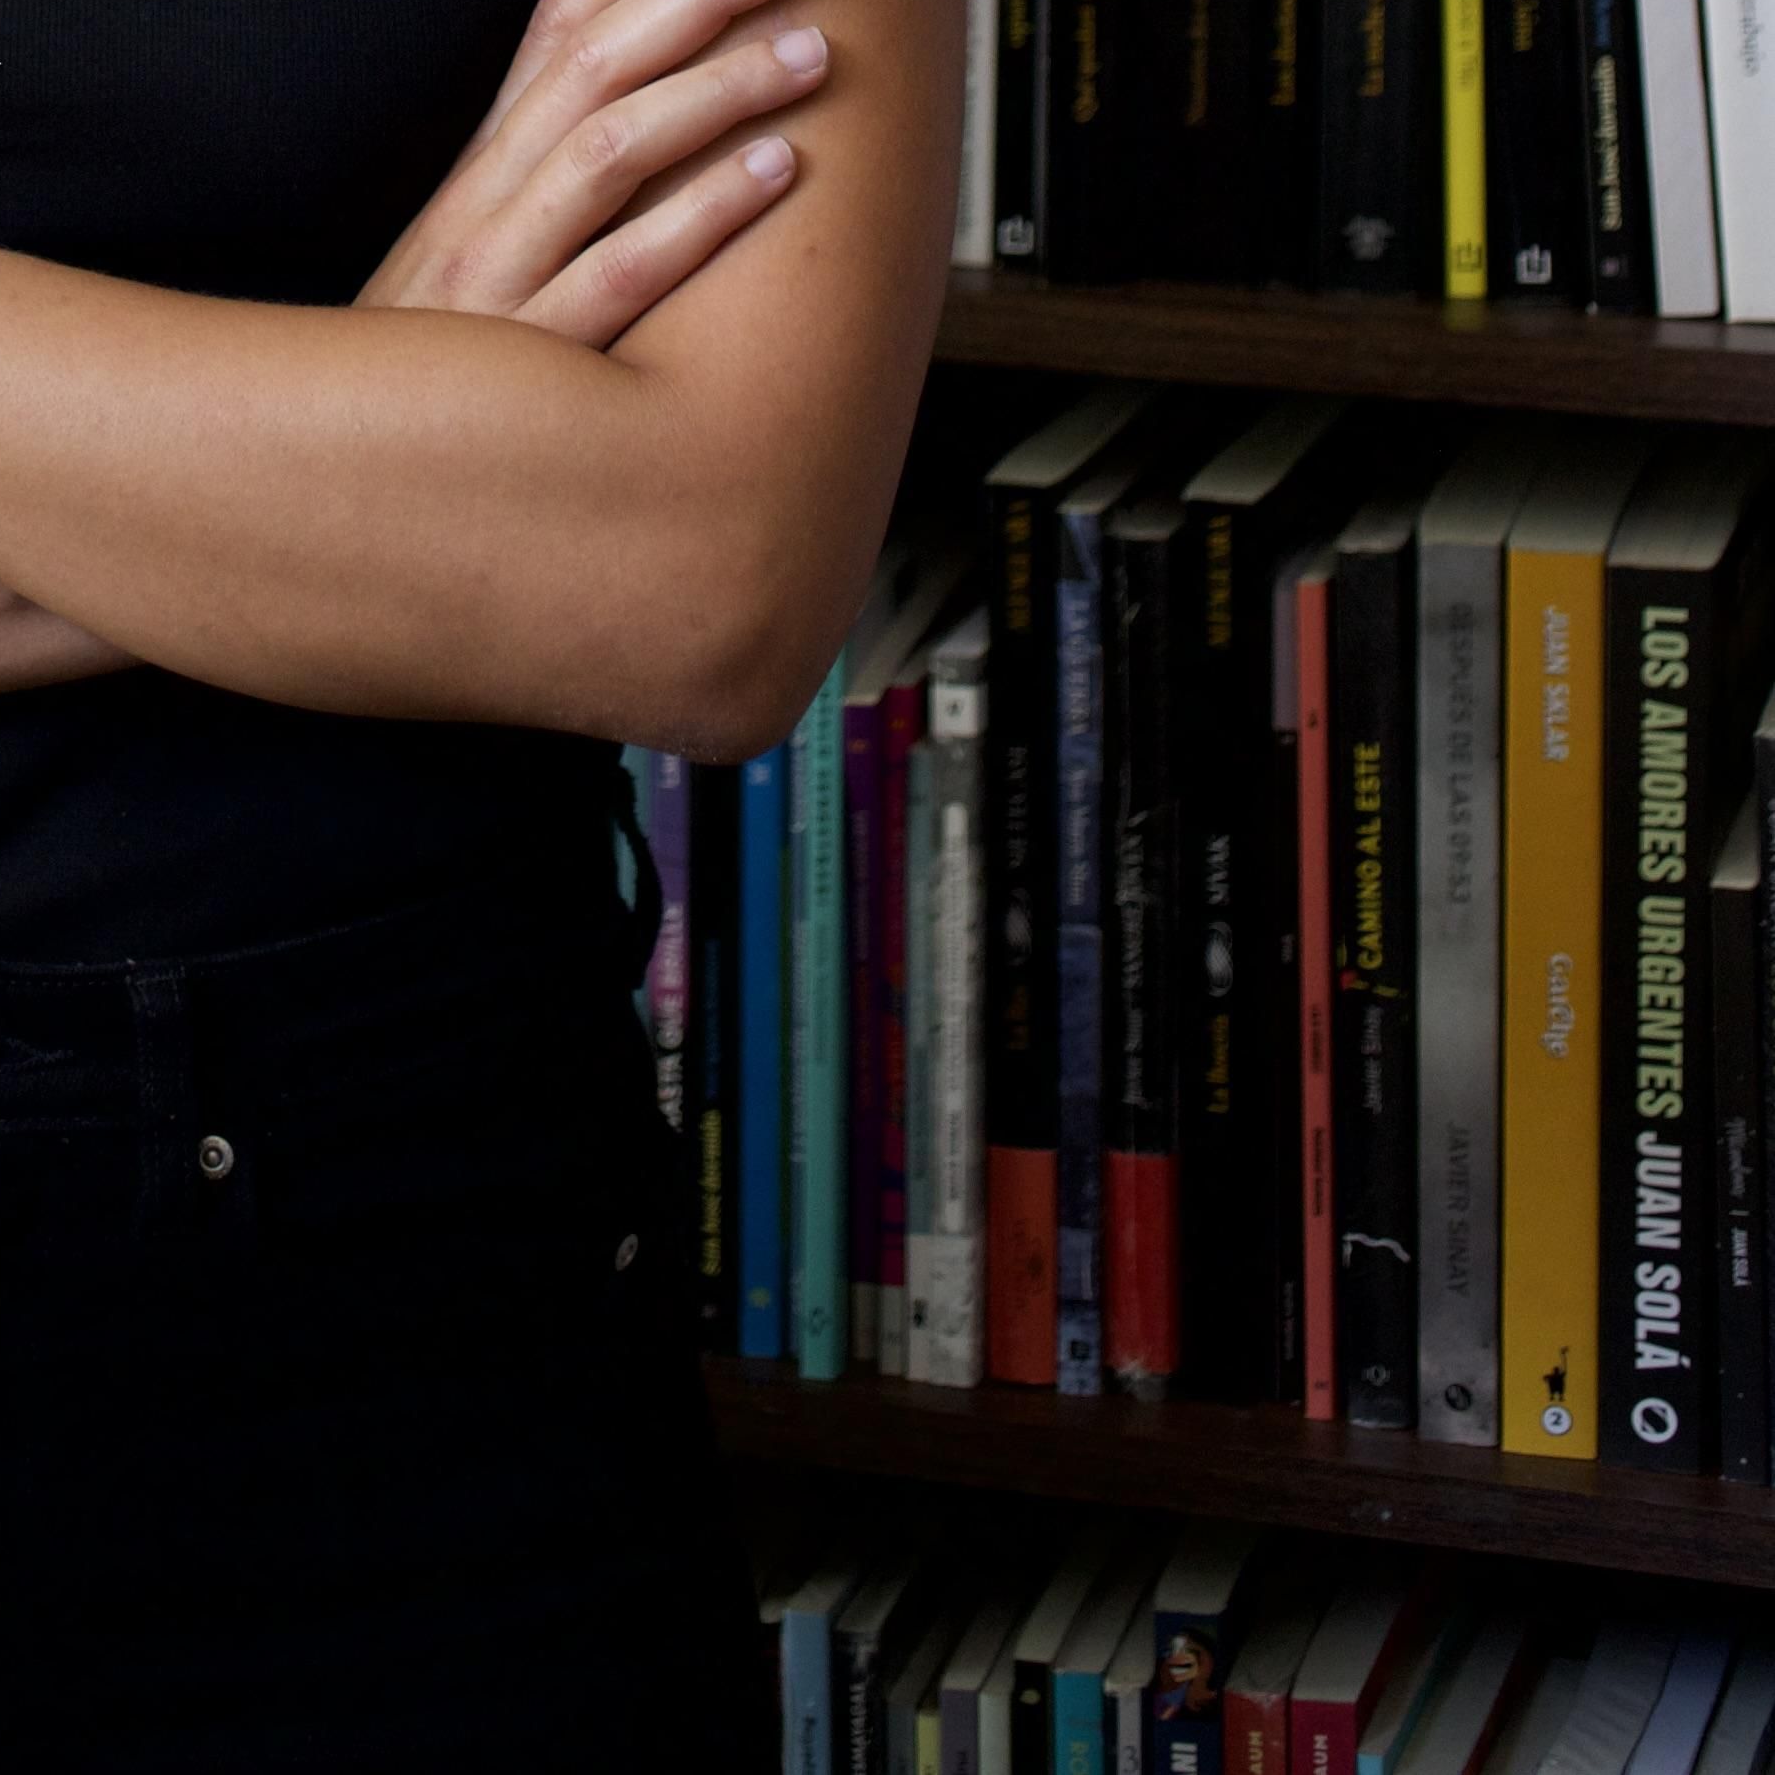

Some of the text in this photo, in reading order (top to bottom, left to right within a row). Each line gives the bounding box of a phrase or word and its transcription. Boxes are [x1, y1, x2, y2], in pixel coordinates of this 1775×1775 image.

[1443, 602, 1479, 720] DESPUÉS
[1542, 603, 1571, 763] JUAN SKLAR
[1445, 726, 1472, 763] DE
[1445, 771, 1472, 827] LAS
[1353, 741, 1385, 969] CAMINO AL ESTE
[1635, 606, 1691, 1369] LOS AMORES URGENTES JUAN SOLÁ
[1443, 1120, 1472, 1299] JAVIER SINAY
[1730, 1227, 1751, 1288] JUAN SOLÁ
